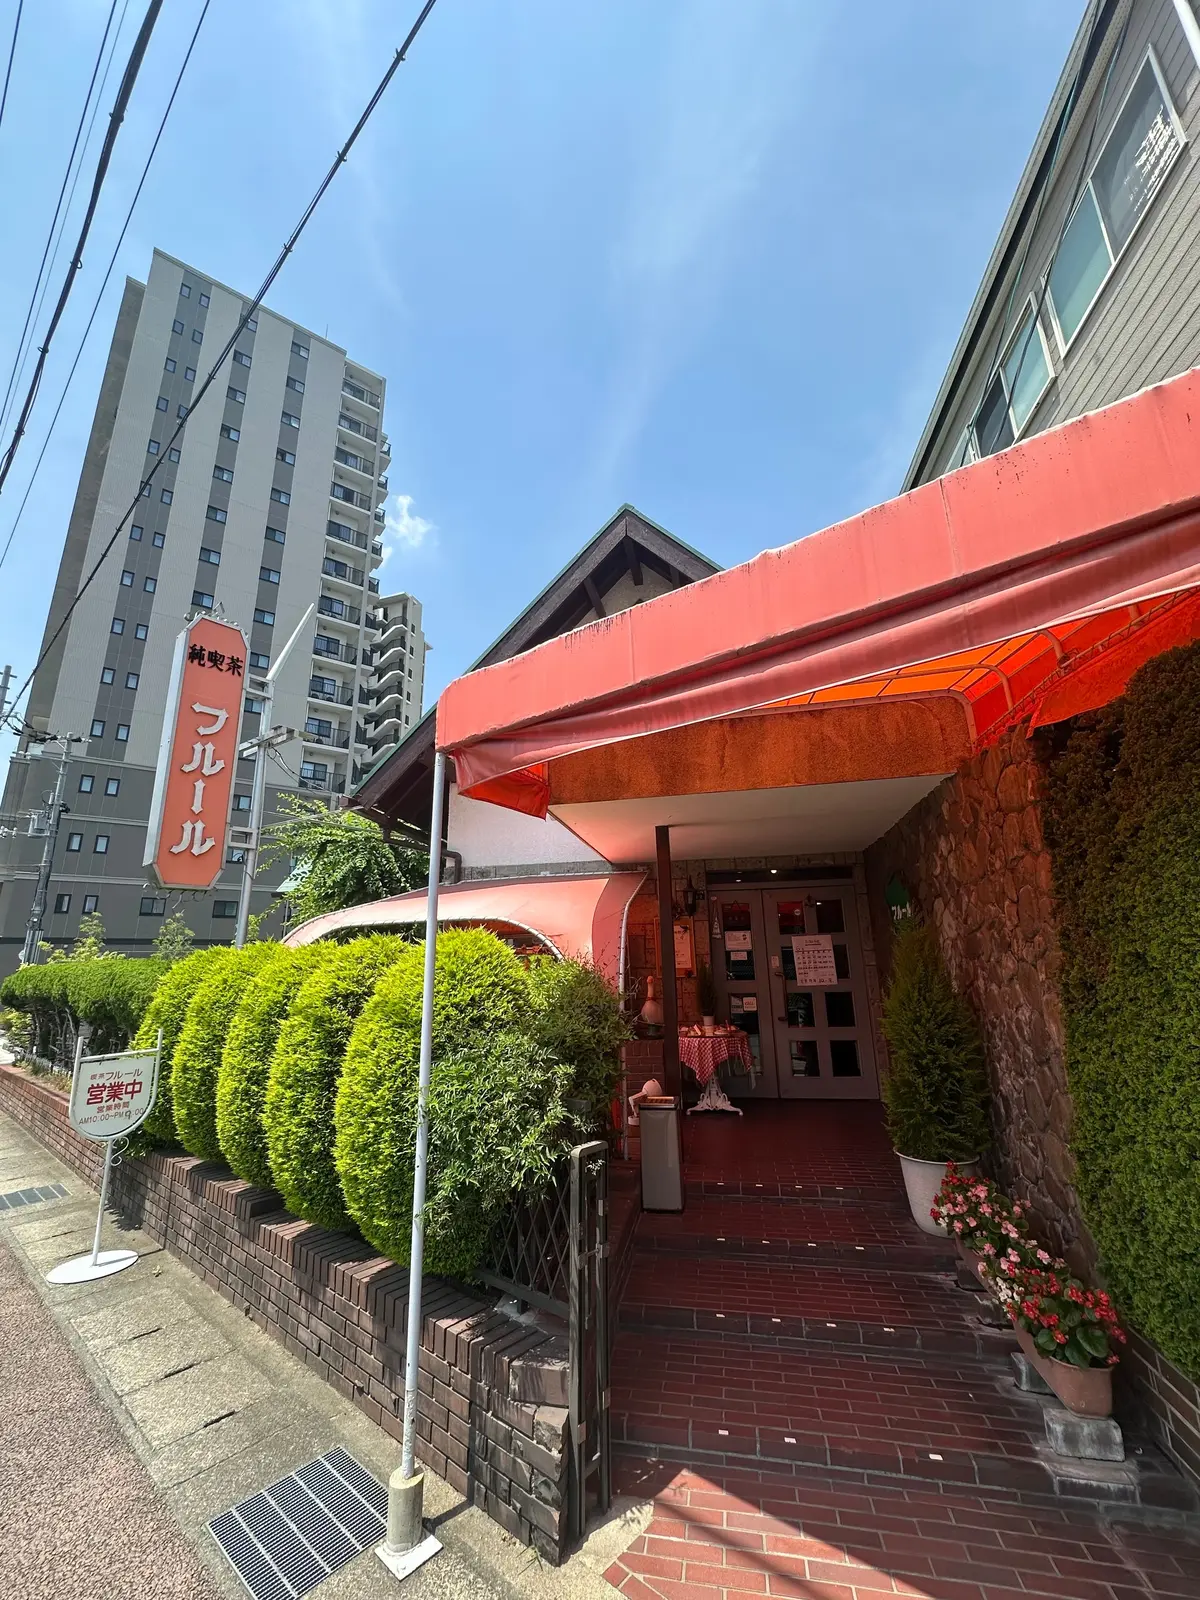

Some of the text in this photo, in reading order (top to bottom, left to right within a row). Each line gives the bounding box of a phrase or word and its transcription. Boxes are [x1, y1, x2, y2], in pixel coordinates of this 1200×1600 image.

[187, 643, 244, 676] 純喫茶
[169, 701, 229, 857] フルール
[86, 1079, 143, 1105] 営業中
[96, 1101, 130, 1114] 営業時間
